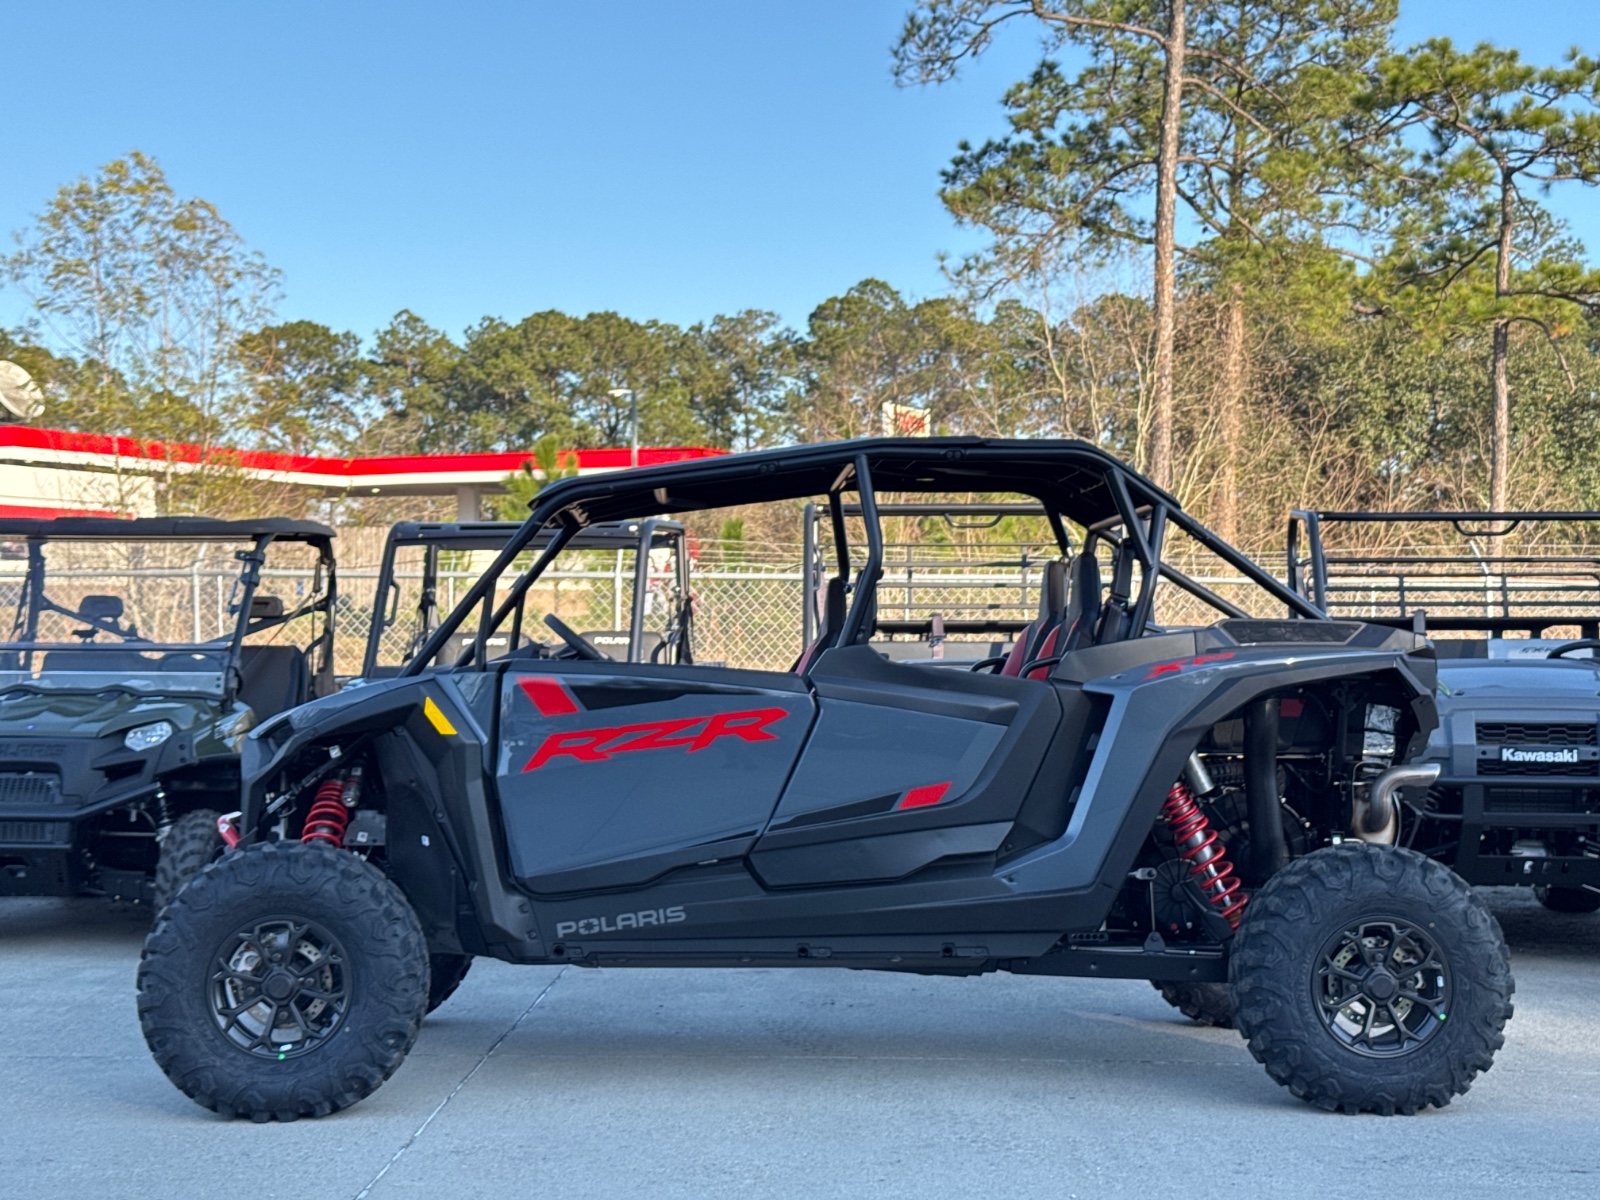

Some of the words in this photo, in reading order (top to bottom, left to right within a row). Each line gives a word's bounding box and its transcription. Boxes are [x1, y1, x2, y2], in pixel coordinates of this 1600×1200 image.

[594, 636, 631, 645] POLAR
[521, 707, 790, 774] RZR
[1501, 748, 1579, 763] Kawasaki
[556, 905, 687, 938] POLARIS
